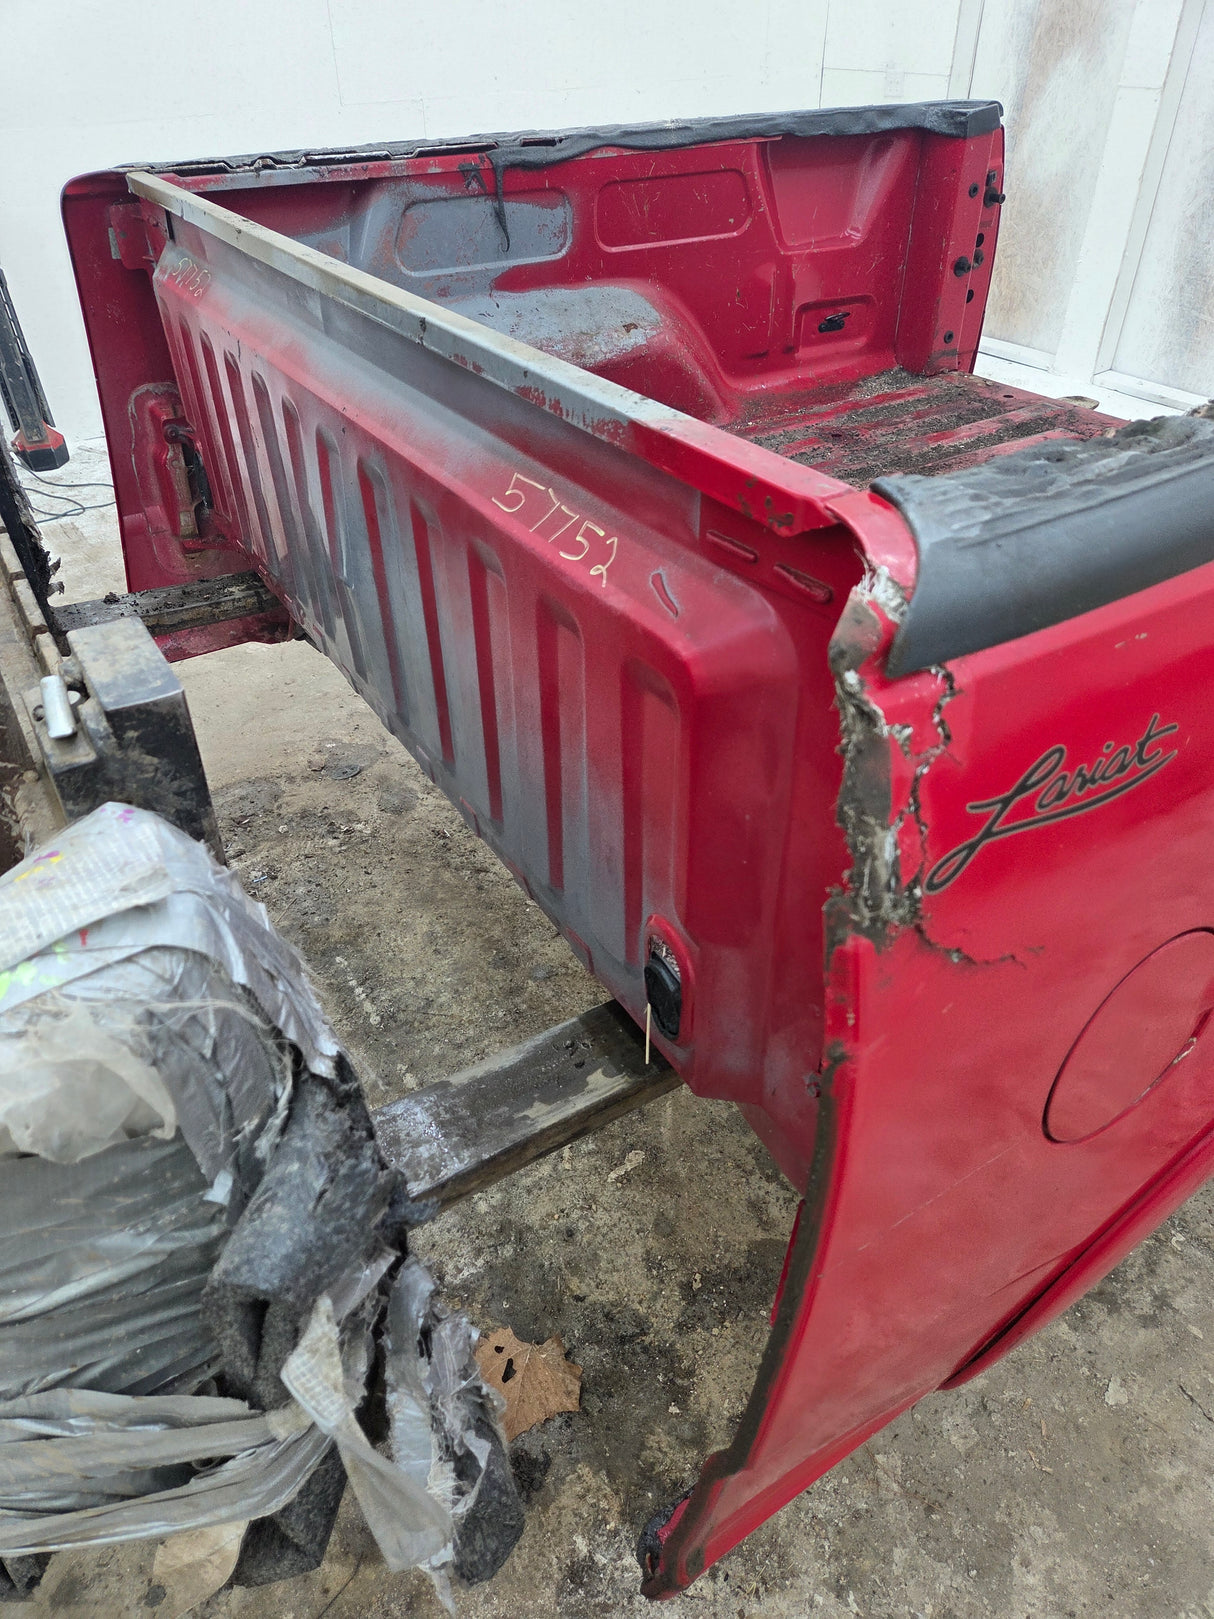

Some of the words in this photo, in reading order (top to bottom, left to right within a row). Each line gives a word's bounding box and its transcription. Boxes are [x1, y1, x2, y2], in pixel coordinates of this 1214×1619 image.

[172, 257, 211, 297] 57752
[491, 472, 618, 588] 57752
[922, 712, 1179, 894] Lariat
